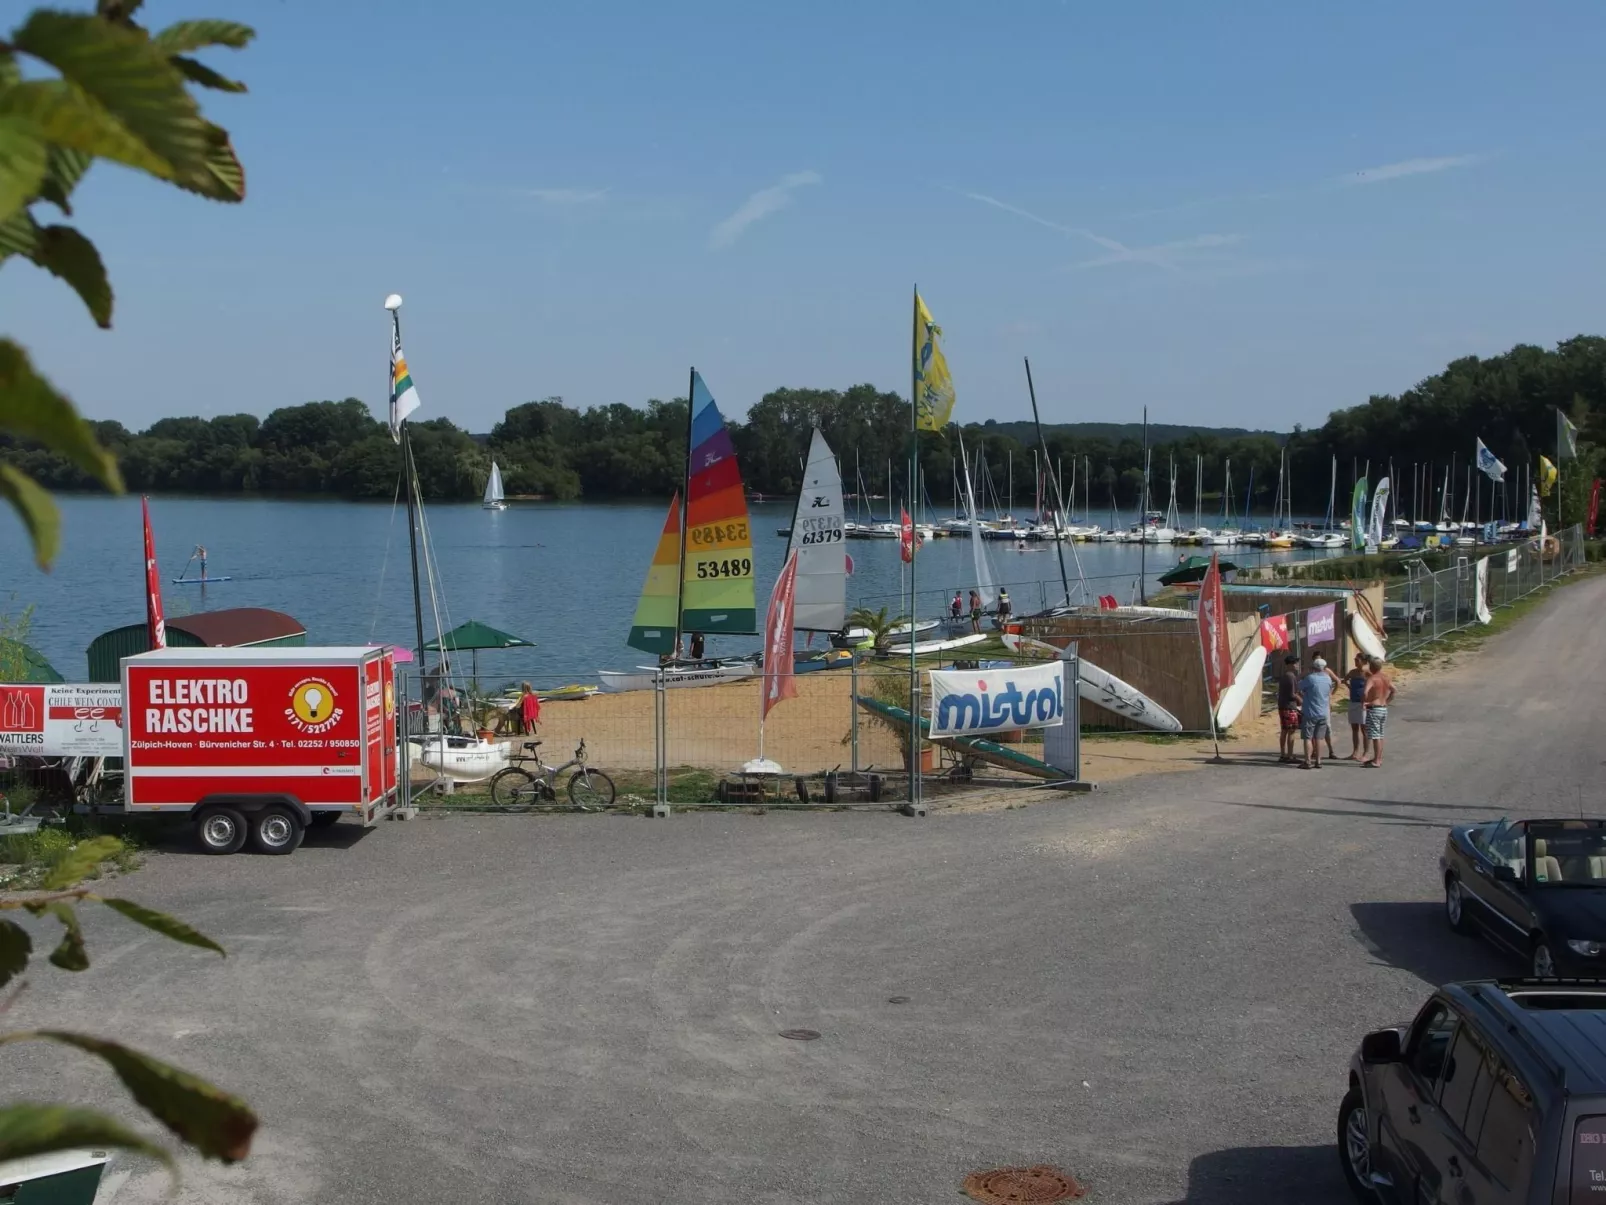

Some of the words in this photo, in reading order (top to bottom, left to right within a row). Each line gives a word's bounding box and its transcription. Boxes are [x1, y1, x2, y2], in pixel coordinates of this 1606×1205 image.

[802, 529, 842, 545] 61379
[696, 558, 752, 579] 53489
[48, 697, 73, 706] CHILE
[74, 697, 94, 706] WEIN
[149, 679, 248, 704] ELEKTRO
[937, 675, 1064, 731] mistral
[146, 708, 254, 733] RASCHKE
[284, 708, 344, 734] 0171/5227228
[131, 740, 193, 750] Zülpich-Hoven
[199, 740, 251, 749] Bürvenicher
[253, 740, 267, 748] Str.
[269, 740, 275, 748] 4
[281, 740, 296, 748] Tel.
[298, 740, 323, 748] 02252
[329, 740, 360, 748] 950850
